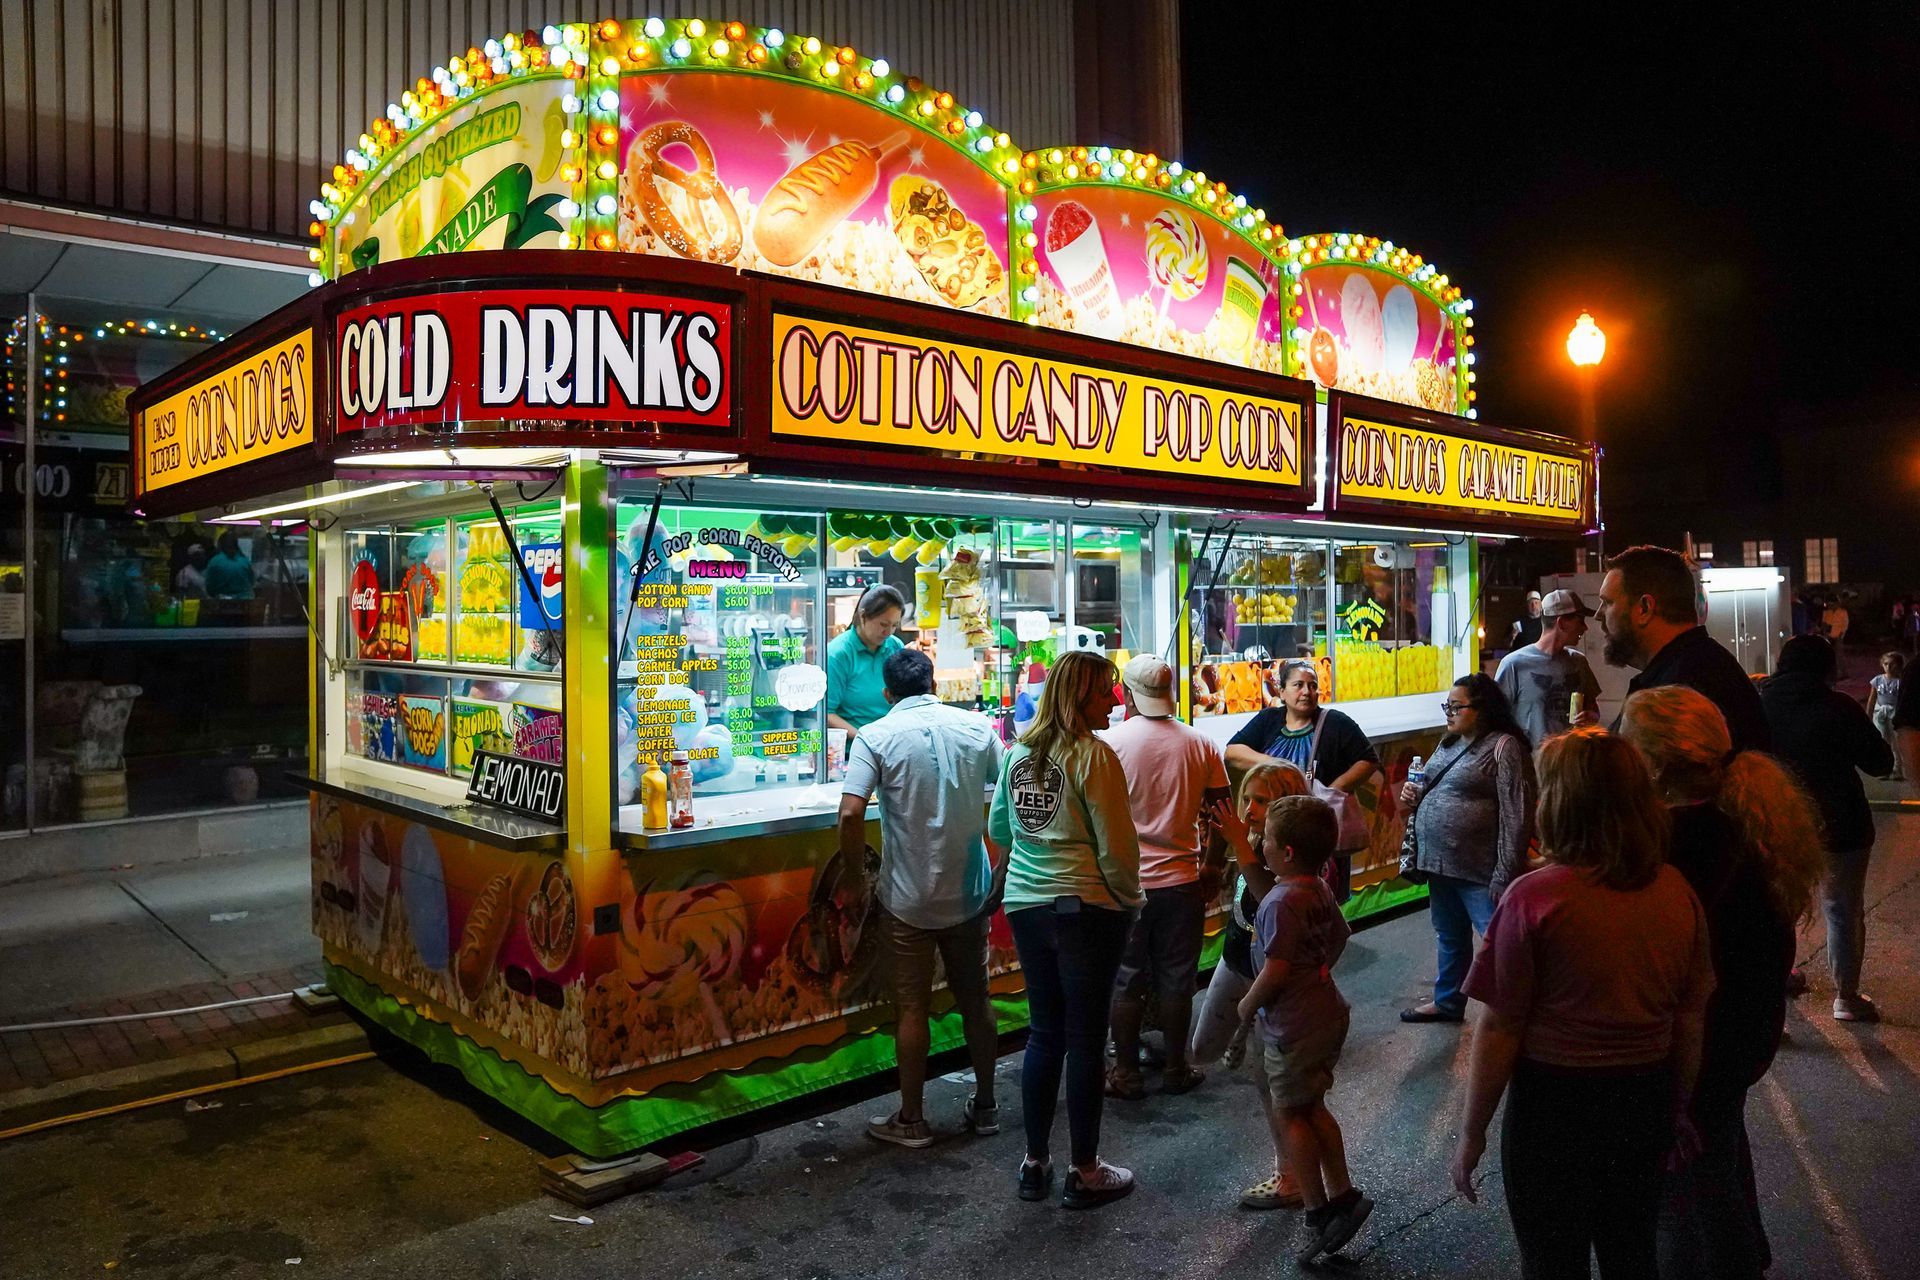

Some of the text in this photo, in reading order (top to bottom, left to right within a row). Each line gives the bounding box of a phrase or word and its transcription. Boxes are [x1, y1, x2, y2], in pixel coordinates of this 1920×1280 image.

[370, 101, 521, 224] FRESH SQUEEZED
[340, 306, 722, 416] COLD DRINKS
[186, 343, 306, 469] CORN DOGS
[780, 325, 1297, 474] COTTON CANDY POP CORN
[153, 411, 176, 443] HAND
[150, 442, 180, 475] DIPPED
[1341, 423, 1582, 511] CORN DOGS CARAMEL APPLES
[524, 547, 562, 574] PEPS
[662, 532, 692, 557] POP
[699, 528, 740, 545] CORN
[744, 534, 800, 582] FACTORY
[689, 560, 746, 578] MENU
[638, 584, 774, 595] COTTON CANDY $6.00 $11.00
[637, 597, 749, 608] POP CORN $6.00
[637, 635, 750, 647] PRETZELS $6.00
[637, 648, 678, 659] NACHOS
[782, 650, 802, 660] $1.00
[637, 660, 751, 672] CARMEL APPLES $6.00
[637, 672, 751, 685] CORN DOG $6.00
[637, 685, 752, 699] POP $2.00
[637, 700, 690, 712] LEMONADE
[755, 696, 777, 707] $8.00
[411, 706, 433, 731] CORN
[637, 709, 753, 725] SHAVED ICE $6.00
[515, 714, 563, 749] CARAMEL
[637, 721, 753, 738] WATER $2.00
[412, 730, 435, 756] DOGS
[731, 733, 753, 744] $1.00
[762, 732, 798, 744] SIPPERS
[731, 746, 754, 757] $1.00
[764, 743, 822, 757] REFILLS $6.00
[1015, 791, 1055, 809] JEEP
[1020, 809, 1047, 818] OUTPOST
